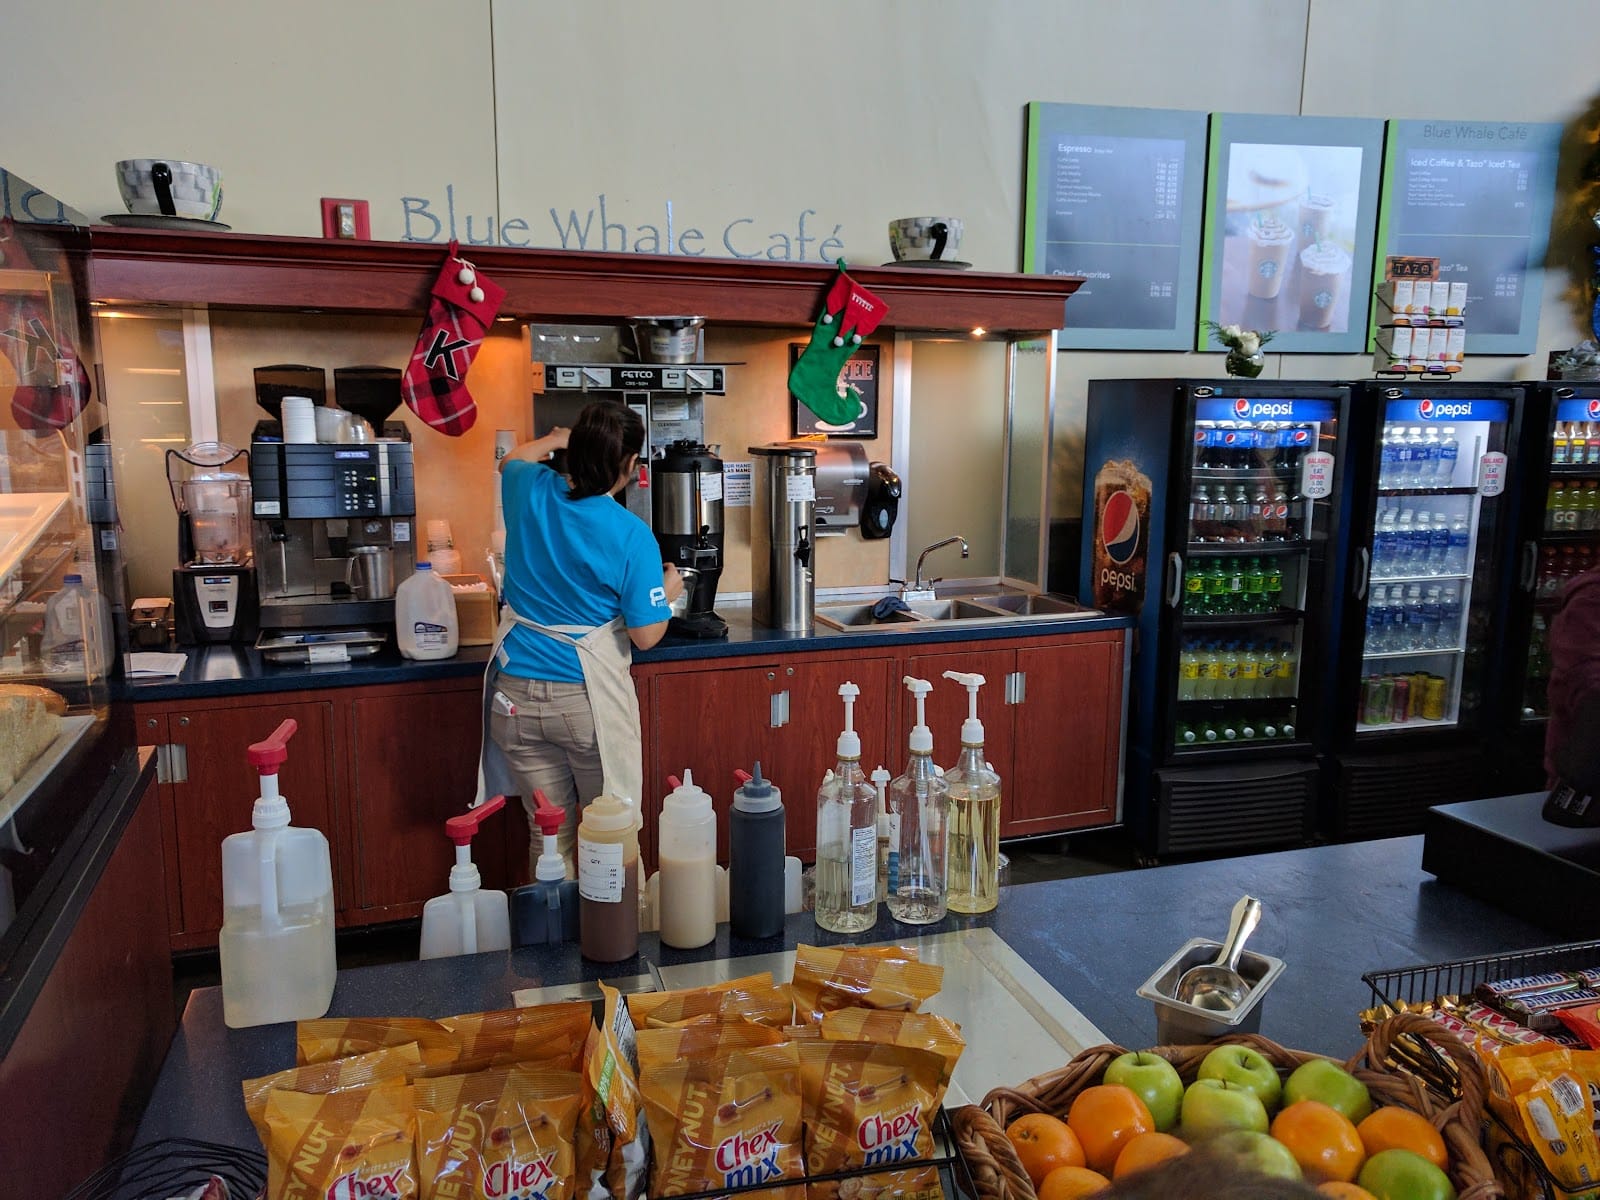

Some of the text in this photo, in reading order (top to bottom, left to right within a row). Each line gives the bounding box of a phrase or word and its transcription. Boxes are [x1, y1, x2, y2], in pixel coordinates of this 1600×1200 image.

[1057, 143, 1093, 155] Espresso
[1423, 125, 1528, 140] Blue Whale Café
[1410, 158, 1428, 168] Iced
[1429, 158, 1456, 168] Coffee
[1489, 160, 1506, 169] Iced
[401, 184, 846, 263] Blue Whale Café
[1395, 263, 1430, 275] TAZO
[423, 328, 475, 381] K
[620, 370, 654, 379] FETCO
[1252, 401, 1293, 418] pepsi
[1435, 401, 1472, 418] pepsi
[1101, 567, 1135, 592] pepsi
[824, 1062, 849, 1109] NUT
[681, 1082, 708, 1139] NUT
[858, 1106, 920, 1151] Chex
[294, 1120, 335, 1175] NUT
[715, 1122, 780, 1172] Chex
[864, 1130, 920, 1167] mix
[327, 1167, 404, 1200] Chex
[484, 1153, 555, 1197] Chex
[726, 1151, 782, 1189] mix
